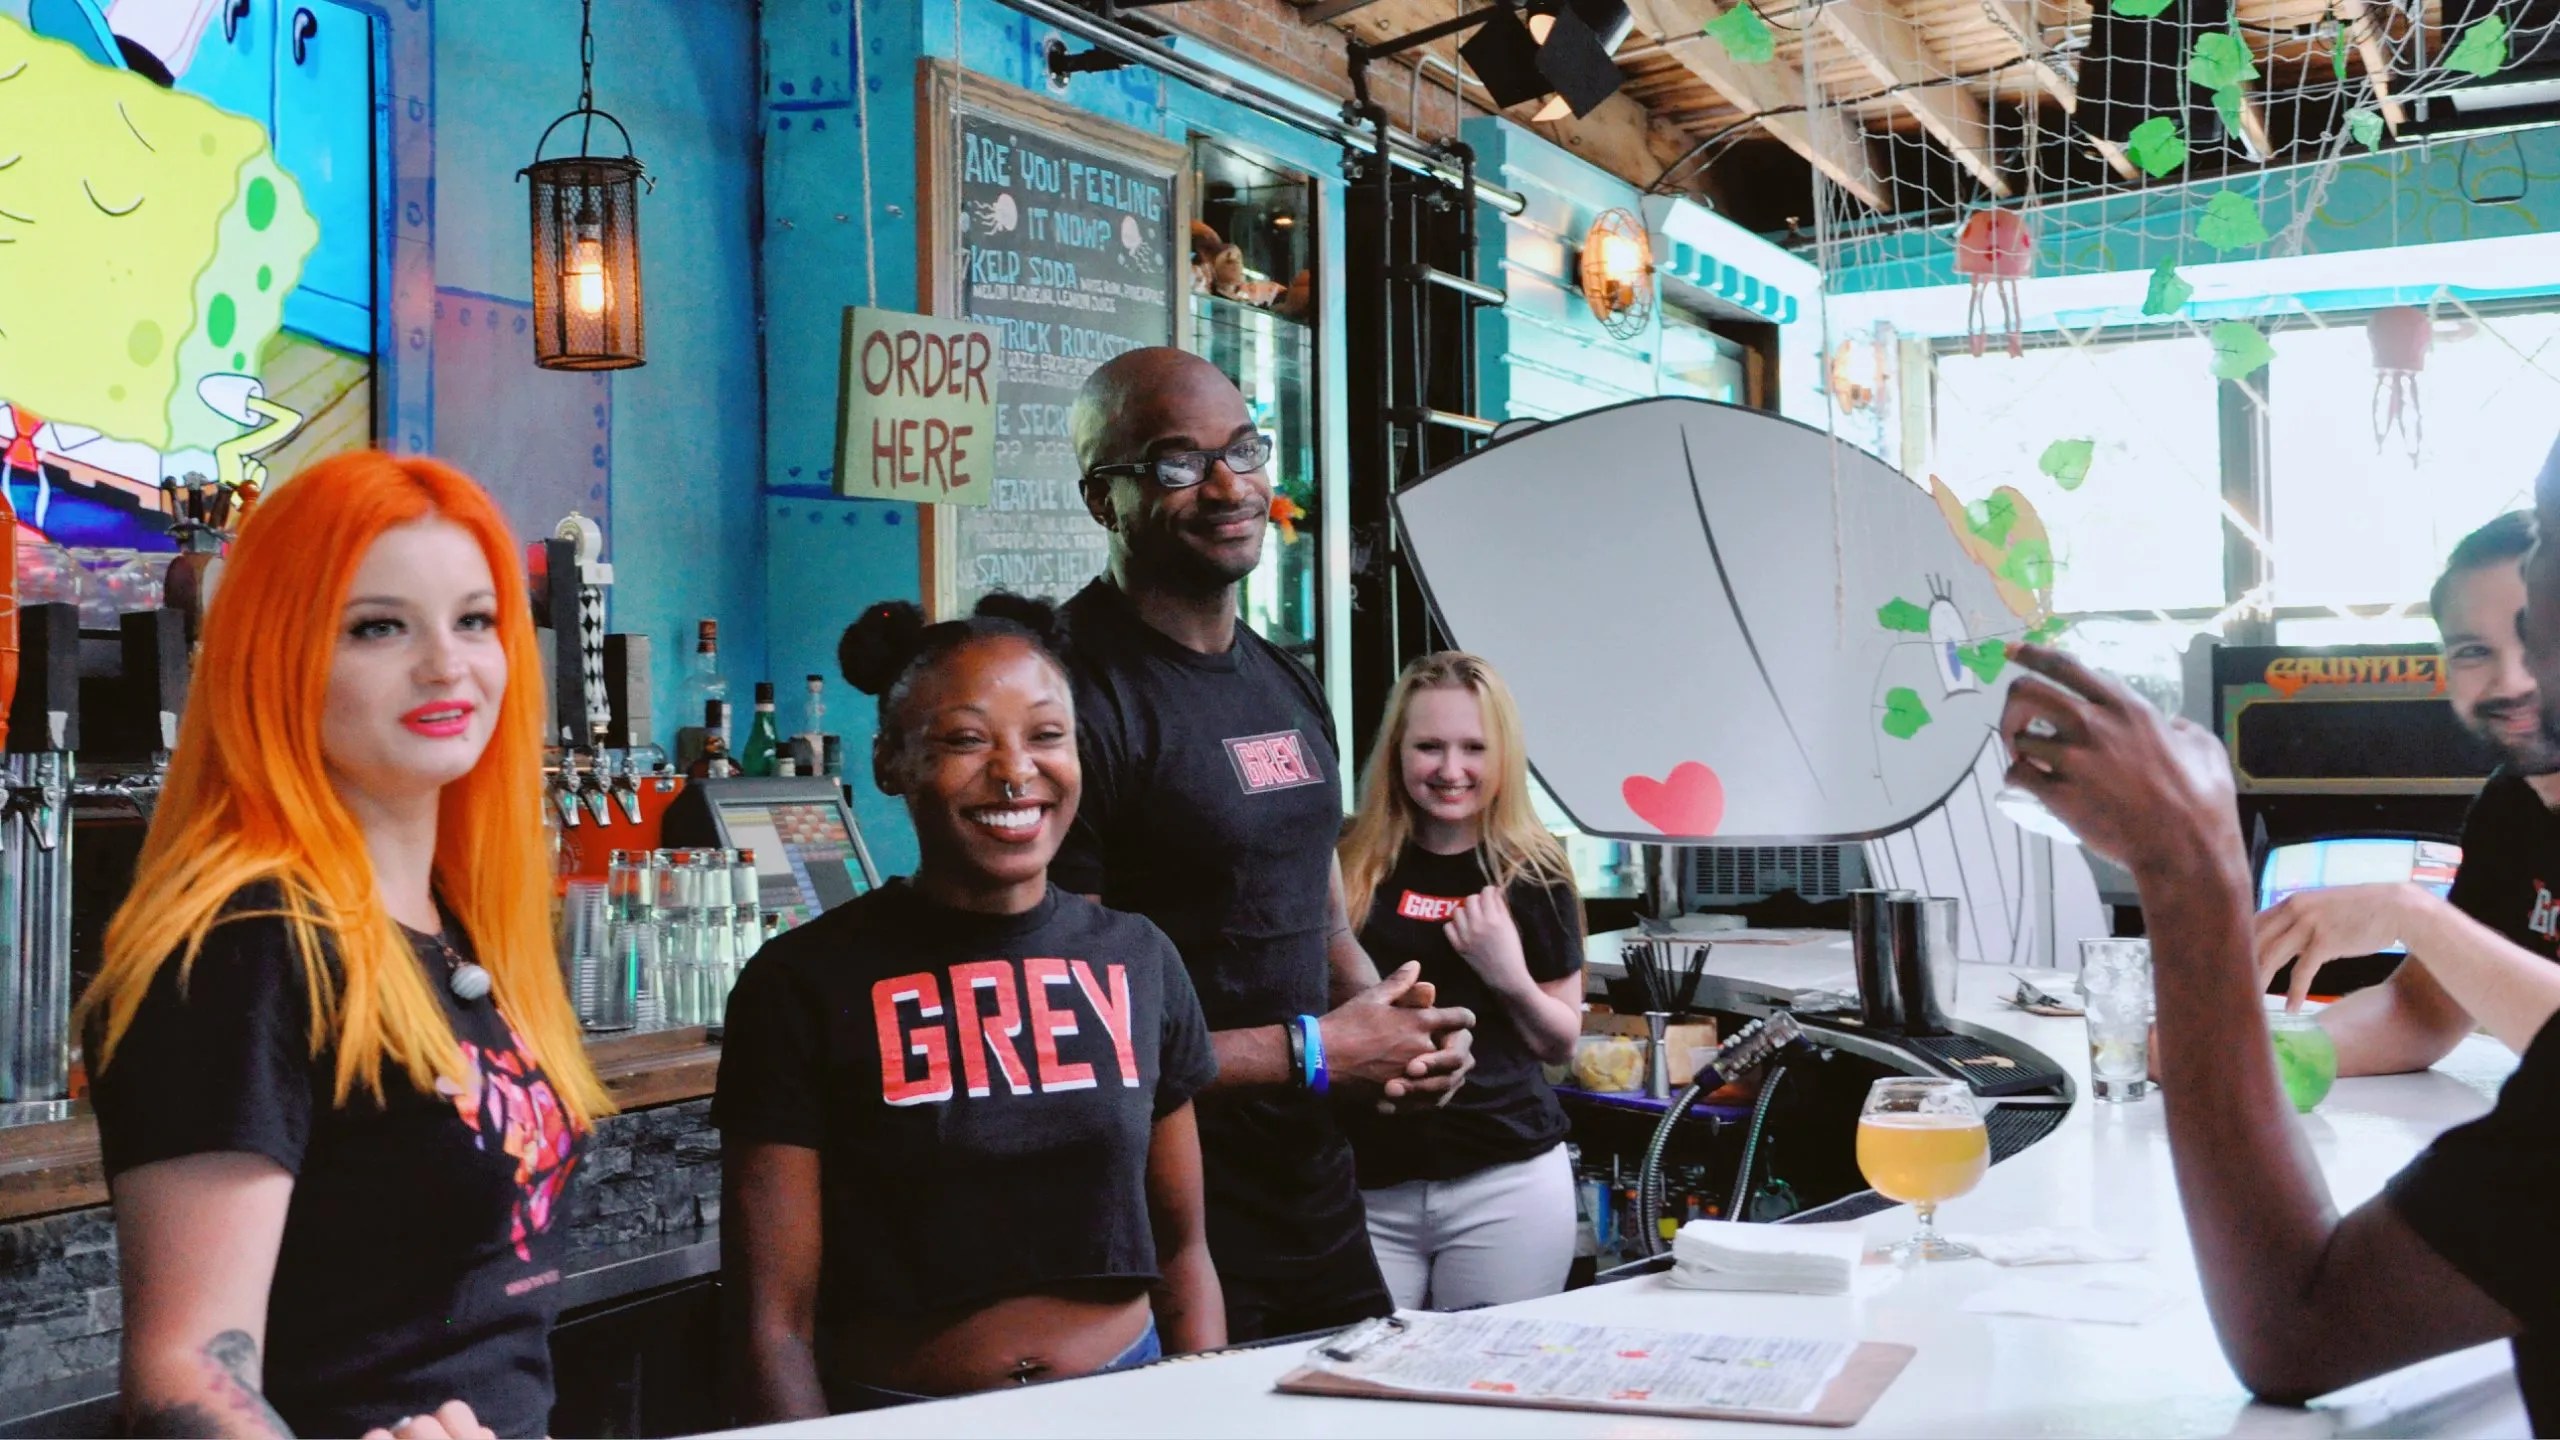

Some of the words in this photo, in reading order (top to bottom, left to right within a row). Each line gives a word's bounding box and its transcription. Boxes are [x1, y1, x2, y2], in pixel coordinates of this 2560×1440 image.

[965, 133, 1010, 187] ARE
[1021, 150, 1060, 193] YOU
[1069, 163, 1160, 222] FEELING
[1028, 207, 1048, 240] IT
[1054, 211, 1112, 251] NOW?
[971, 245, 1020, 284] KELP
[1029, 256, 1077, 289] SODA
[862, 330, 991, 404] ORDER
[872, 418, 973, 494] HERE
[975, 553, 1055, 584] SANDY'S
[2264, 655, 2447, 699] GAUNTLET
[1234, 735, 1310, 788] GREY
[1404, 894, 1462, 919] GREY
[871, 957, 1140, 1107] GREY
